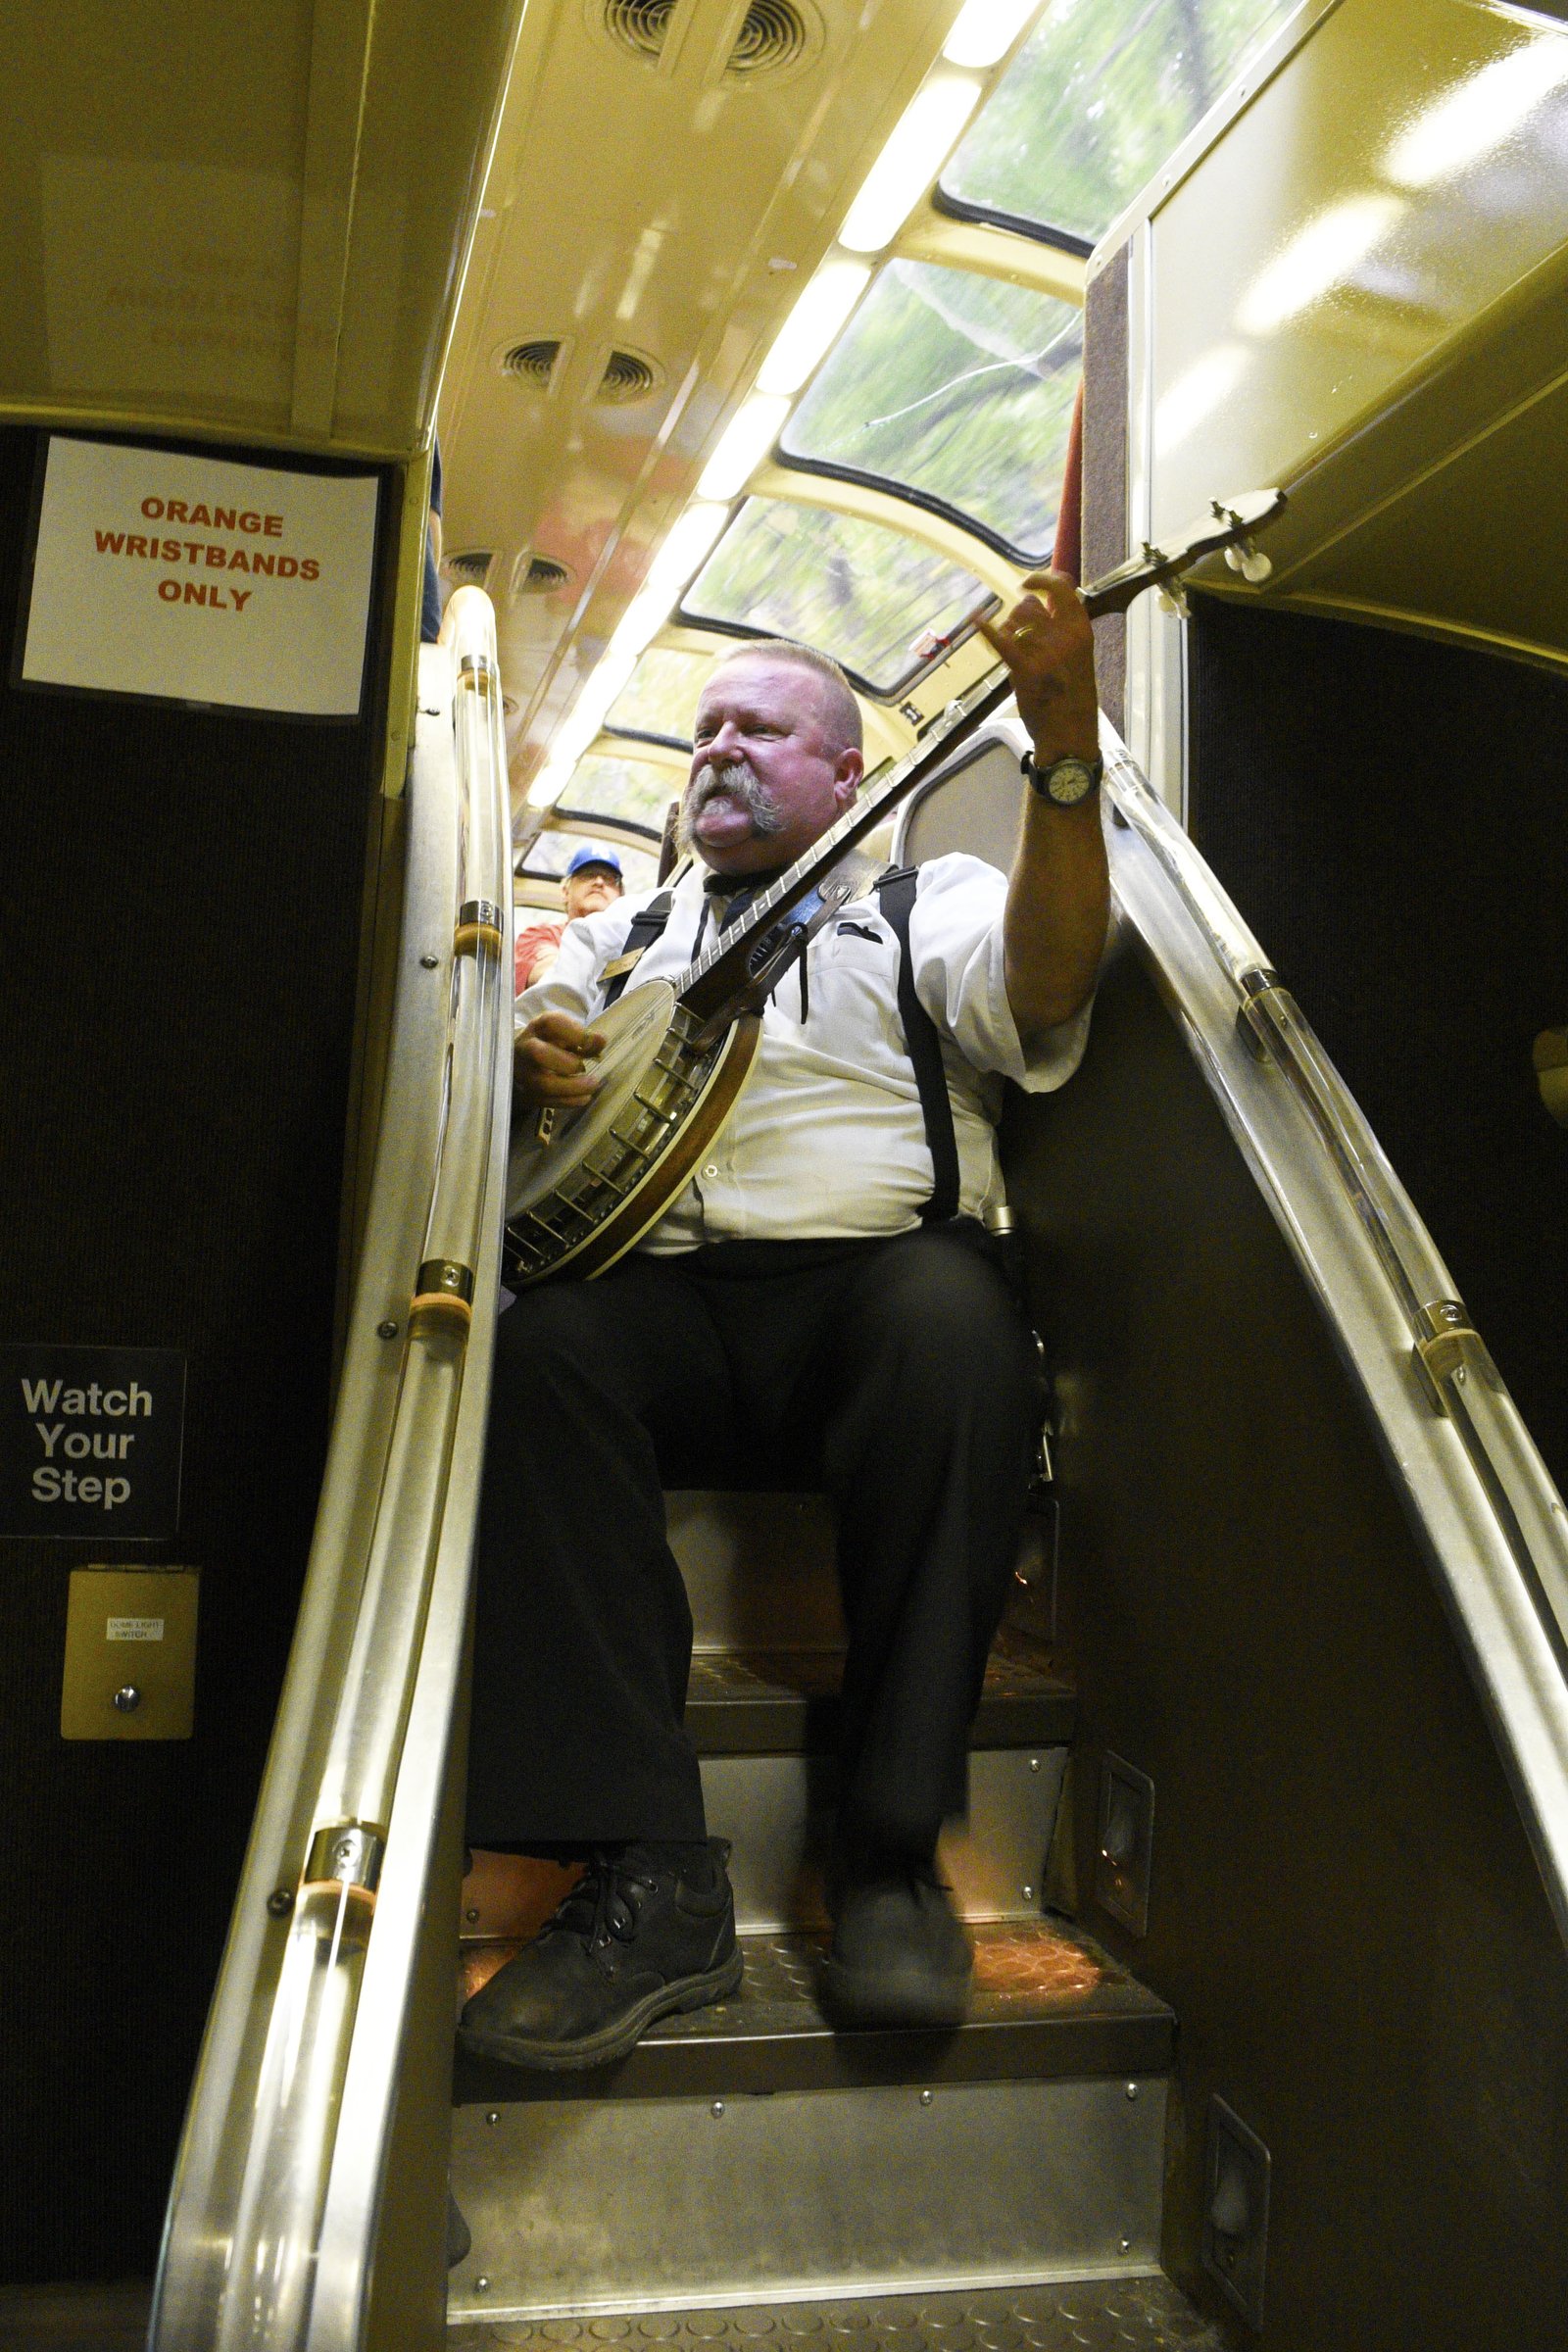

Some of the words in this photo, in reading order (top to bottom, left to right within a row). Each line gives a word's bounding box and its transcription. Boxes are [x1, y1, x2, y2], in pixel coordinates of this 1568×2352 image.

[140, 496, 284, 538] ORANGE
[94, 529, 320, 581] WRISTBANDS
[157, 578, 253, 612] ONLY
[21, 1378, 153, 1417] Watch
[35, 1422, 135, 1460] Your
[31, 1466, 131, 1510] Step
